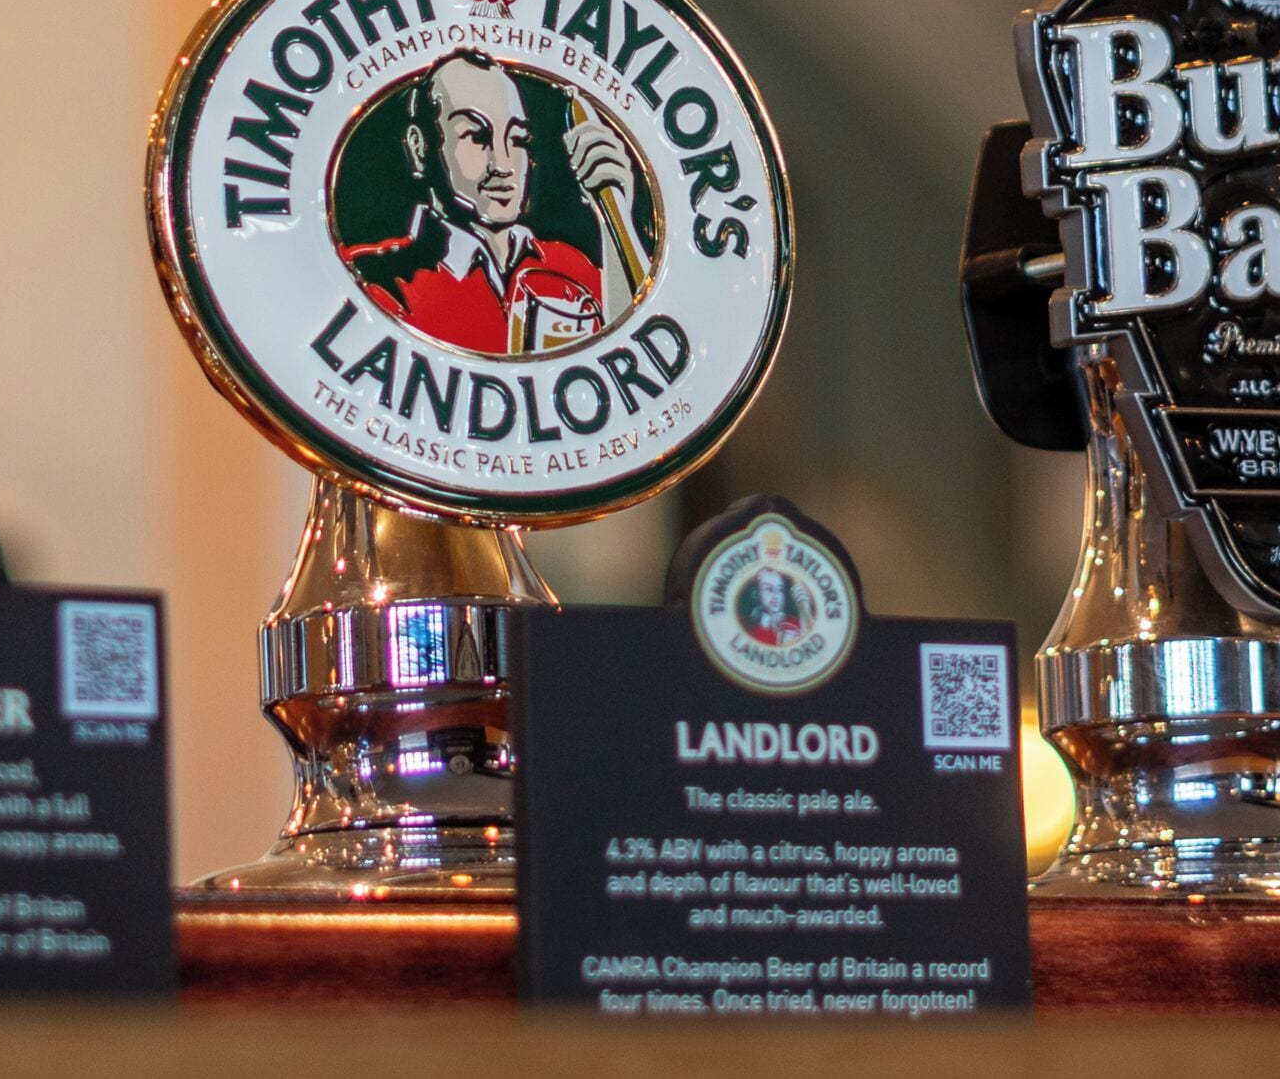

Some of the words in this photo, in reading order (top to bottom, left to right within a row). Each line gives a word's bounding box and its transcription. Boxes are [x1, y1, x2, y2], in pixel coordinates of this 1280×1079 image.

[346, 23, 552, 90] CHAMPIONSHIP
[562, 43, 636, 111] BEERS
[309, 297, 693, 444] LANDLORD
[1239, 380, 1271, 395] ALC
[313, 379, 358, 425] THE
[365, 416, 466, 469] CLASSIC
[476, 454, 533, 475] PALE
[547, 449, 589, 474] ALE
[597, 428, 640, 464] ABV
[646, 400, 693, 438] 4.3%
[1213, 429, 1275, 455] WYE
[708, 542, 760, 615] TIMOTHY
[729, 633, 826, 668] LANDLORD
[675, 721, 878, 762] LANDLORD
[933, 755, 976, 771] SCAN
[979, 755, 1002, 771] ME
[684, 786, 723, 810] The
[726, 787, 794, 810] classic
[798, 789, 839, 816] pale
[843, 789, 880, 811] ale.
[606, 837, 657, 861] 4.3%
[659, 838, 703, 861] ABV
[705, 839, 749, 862] with
[752, 844, 766, 862] a
[769, 840, 832, 865] citrus,
[834, 840, 893, 867] hoppy
[896, 845, 959, 863] aroma
[607, 870, 647, 893] and
[649, 870, 708, 899] depth
[710, 871, 731, 893] of
[733, 871, 802, 893] flavour
[806, 873, 860, 894] that's
[863, 873, 961, 895] well-loved
[13, 892, 85, 921] Britain
[688, 903, 728, 926] and
[37, 927, 111, 957] Britain
[582, 955, 660, 979] CAMRA
[662, 956, 763, 984] Champion
[767, 956, 815, 979] Beer
[818, 957, 839, 979] of
[842, 956, 908, 979] Britain
[911, 962, 924, 979] a
[928, 957, 989, 979] record
[600, 988, 642, 1013] four
[646, 988, 709, 1013] times.
[713, 988, 763, 1012] Once
[767, 989, 818, 1013] tried,
[823, 993, 877, 1011] never
[881, 989, 976, 1018] forgotten!
